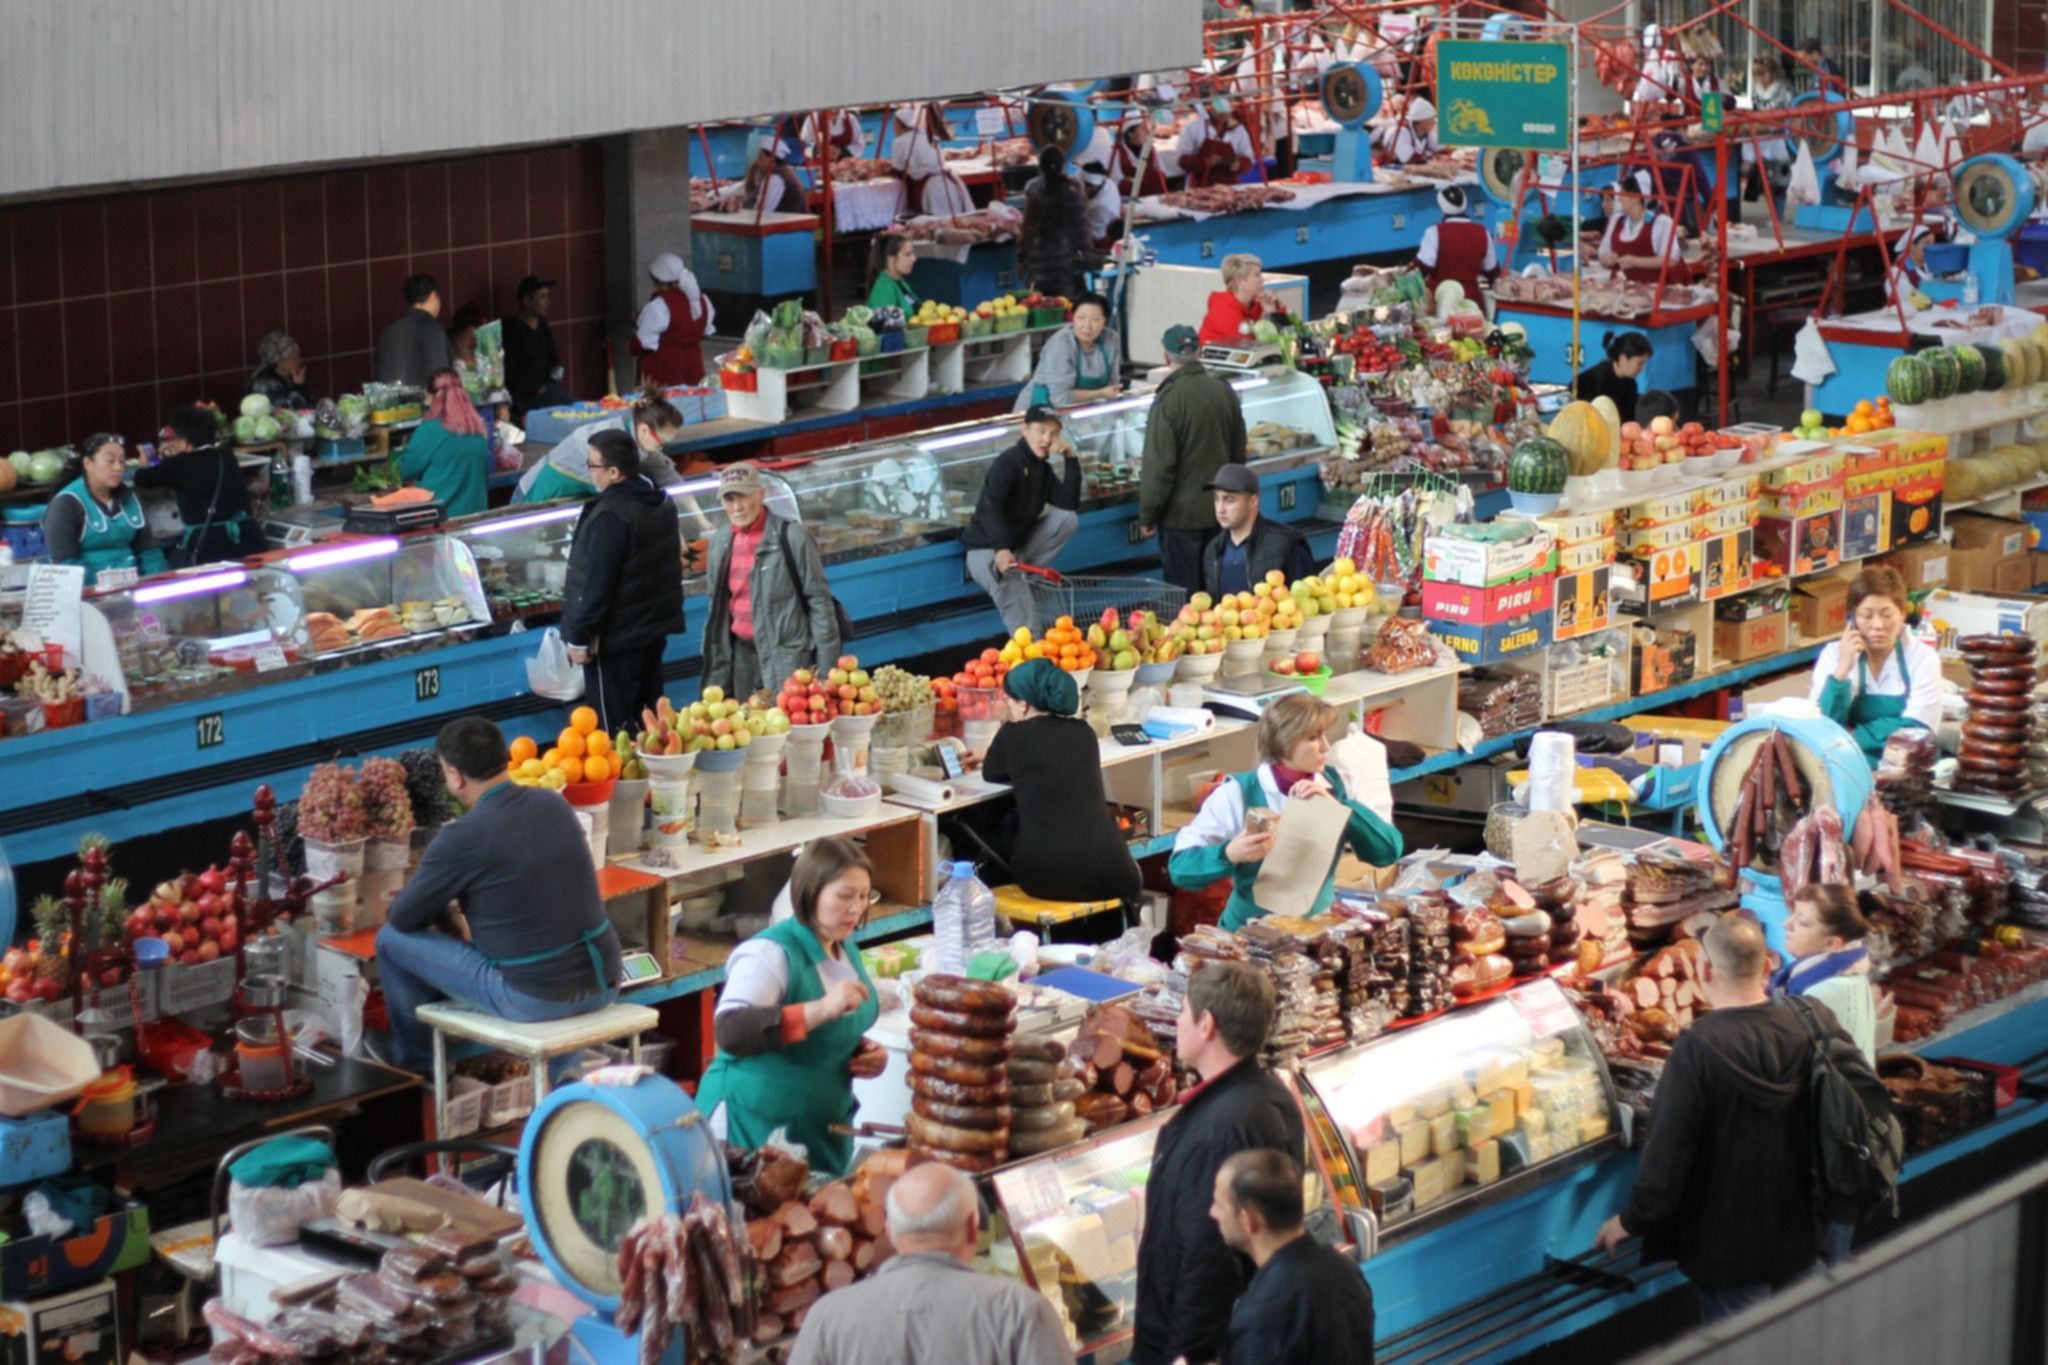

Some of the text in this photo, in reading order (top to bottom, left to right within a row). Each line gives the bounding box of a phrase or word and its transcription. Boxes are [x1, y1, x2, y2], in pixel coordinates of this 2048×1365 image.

[1435, 602, 1469, 615] PIRU
[1497, 590, 1532, 611] PIRU
[1499, 629, 1538, 652] SALERNO
[416, 668, 439, 698] 173
[197, 715, 223, 745] 172
